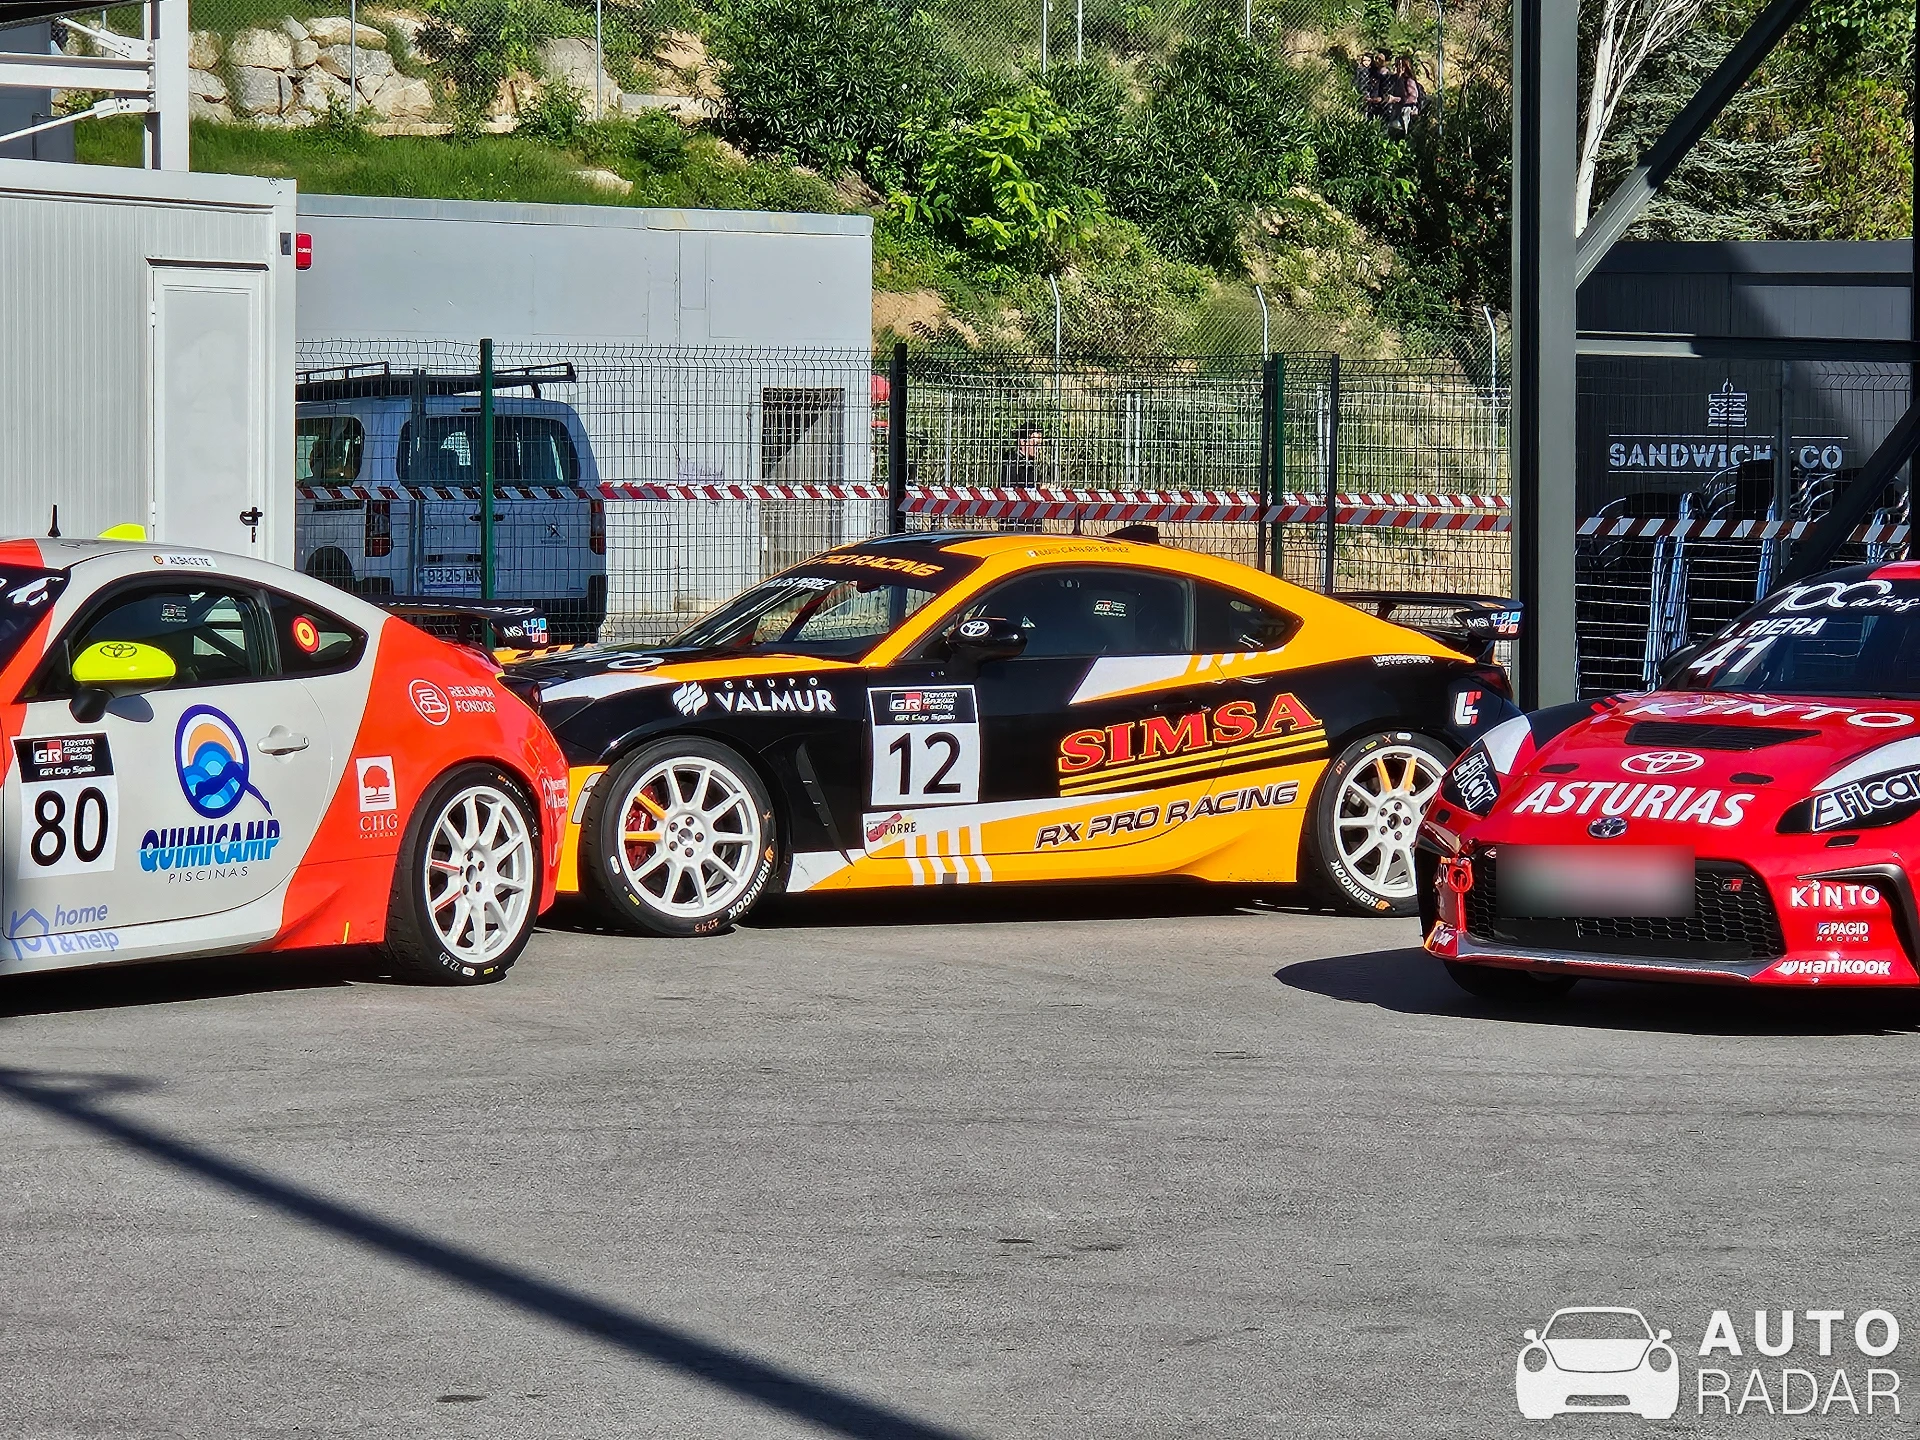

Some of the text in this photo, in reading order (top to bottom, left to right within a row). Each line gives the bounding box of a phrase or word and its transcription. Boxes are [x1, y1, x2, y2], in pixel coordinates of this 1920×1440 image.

[1609, 442, 1843, 469] SANDWICH CO
[1739, 617, 1828, 636] RIERA
[1686, 633, 1779, 677] 41
[724, 677, 819, 690] GRUPO
[455, 699, 497, 713] FONDOS
[715, 689, 837, 712] VALMUR
[891, 699, 920, 710] GR
[931, 713, 956, 722] Spain
[1058, 692, 1323, 772] SIMSA
[35, 749, 61, 763] GR
[888, 731, 962, 796] 12
[1513, 781, 1756, 827] ASTURIAS
[359, 813, 399, 832] CHG
[1035, 780, 1300, 850] RX PRO RACING
[30, 786, 109, 867] 80
[884, 821, 917, 836] TORRE
[139, 819, 281, 873] QUIMICAMP
[168, 866, 249, 884] PISCINAS
[54, 904, 108, 927] home
[1830, 922, 1869, 935] PAGID
